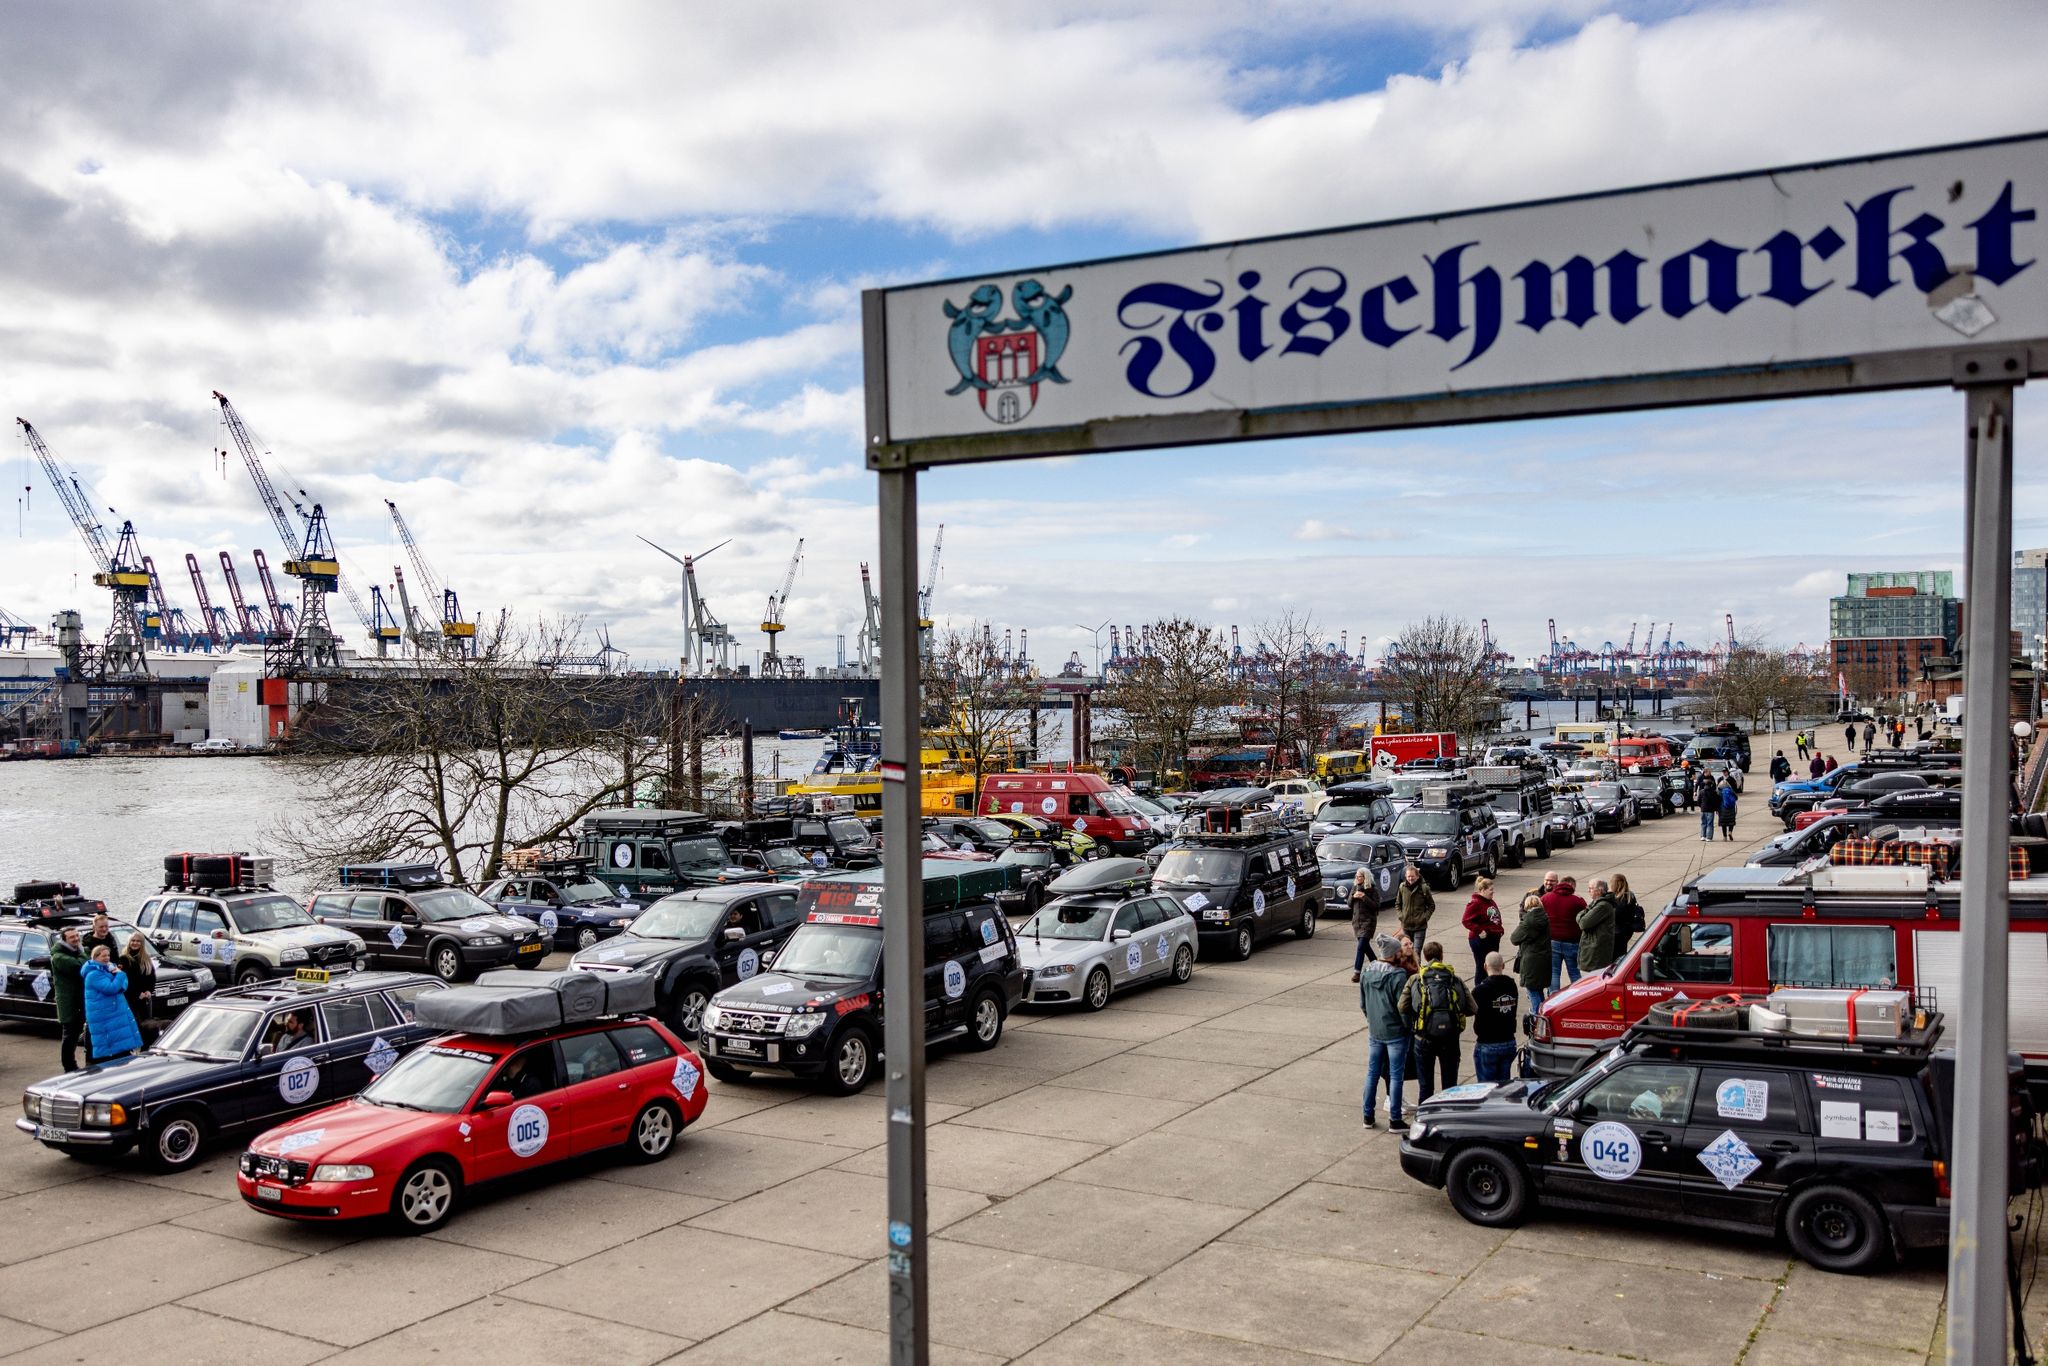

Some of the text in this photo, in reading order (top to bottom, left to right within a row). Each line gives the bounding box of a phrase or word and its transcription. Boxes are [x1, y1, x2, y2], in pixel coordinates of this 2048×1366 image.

[1115, 180, 2037, 399] Fischmarkt
[201, 943, 213, 955] 038
[742, 958, 754, 972] 057
[301, 971, 321, 980] TAXI
[749, 1002, 779, 1011] ADVENTURE
[779, 1005, 793, 1013] CLUB
[288, 1071, 311, 1091] 027
[517, 1120, 540, 1143] 005
[1593, 1139, 1630, 1164] 042
[1704, 1160, 1723, 1175] BALTIC
